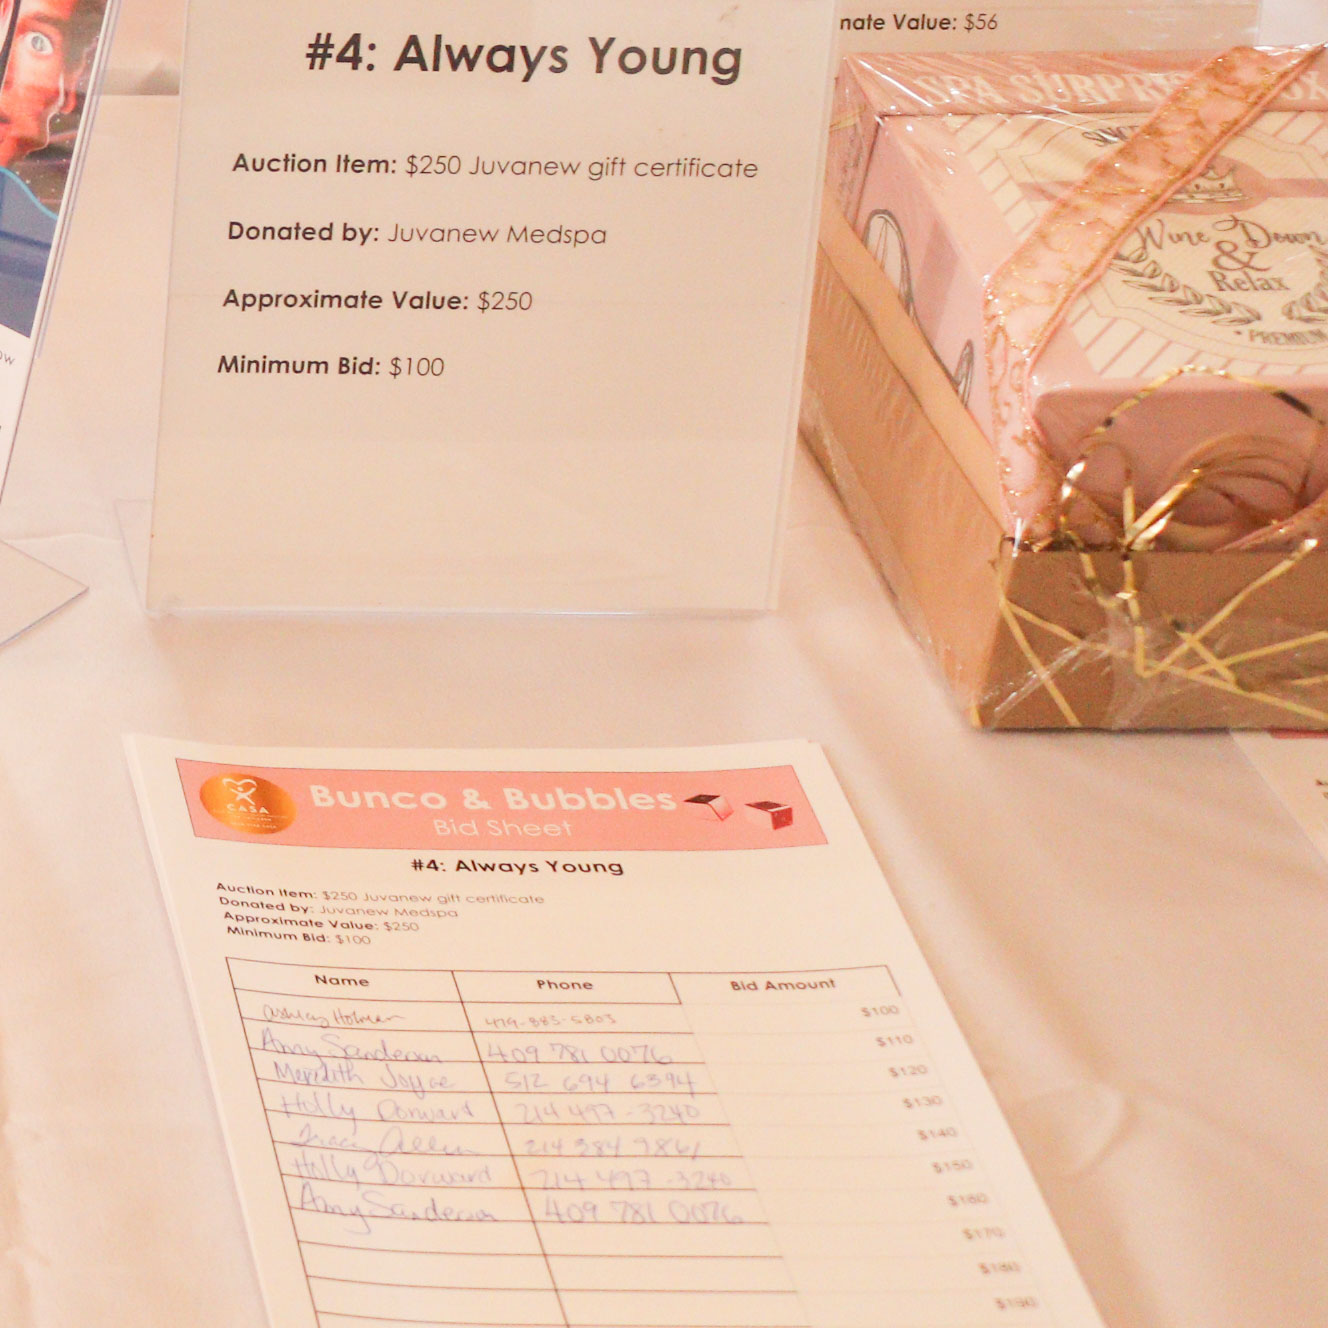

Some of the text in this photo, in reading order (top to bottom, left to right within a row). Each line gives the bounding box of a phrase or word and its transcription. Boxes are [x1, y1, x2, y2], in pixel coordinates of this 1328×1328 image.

[304, 31, 742, 86] #4: Always Young
[915, 76, 1007, 106] SPA
[231, 152, 758, 181] Auction Item: $250 Juvanew gift certificate
[1134, 215, 1326, 249] Wine Down
[1210, 241, 1273, 272] &
[1211, 271, 1289, 291] Relax
[411, 858, 624, 876] #4: Always Young
[217, 883, 544, 905] Auction Item: $250 Juvanew gift certificate
